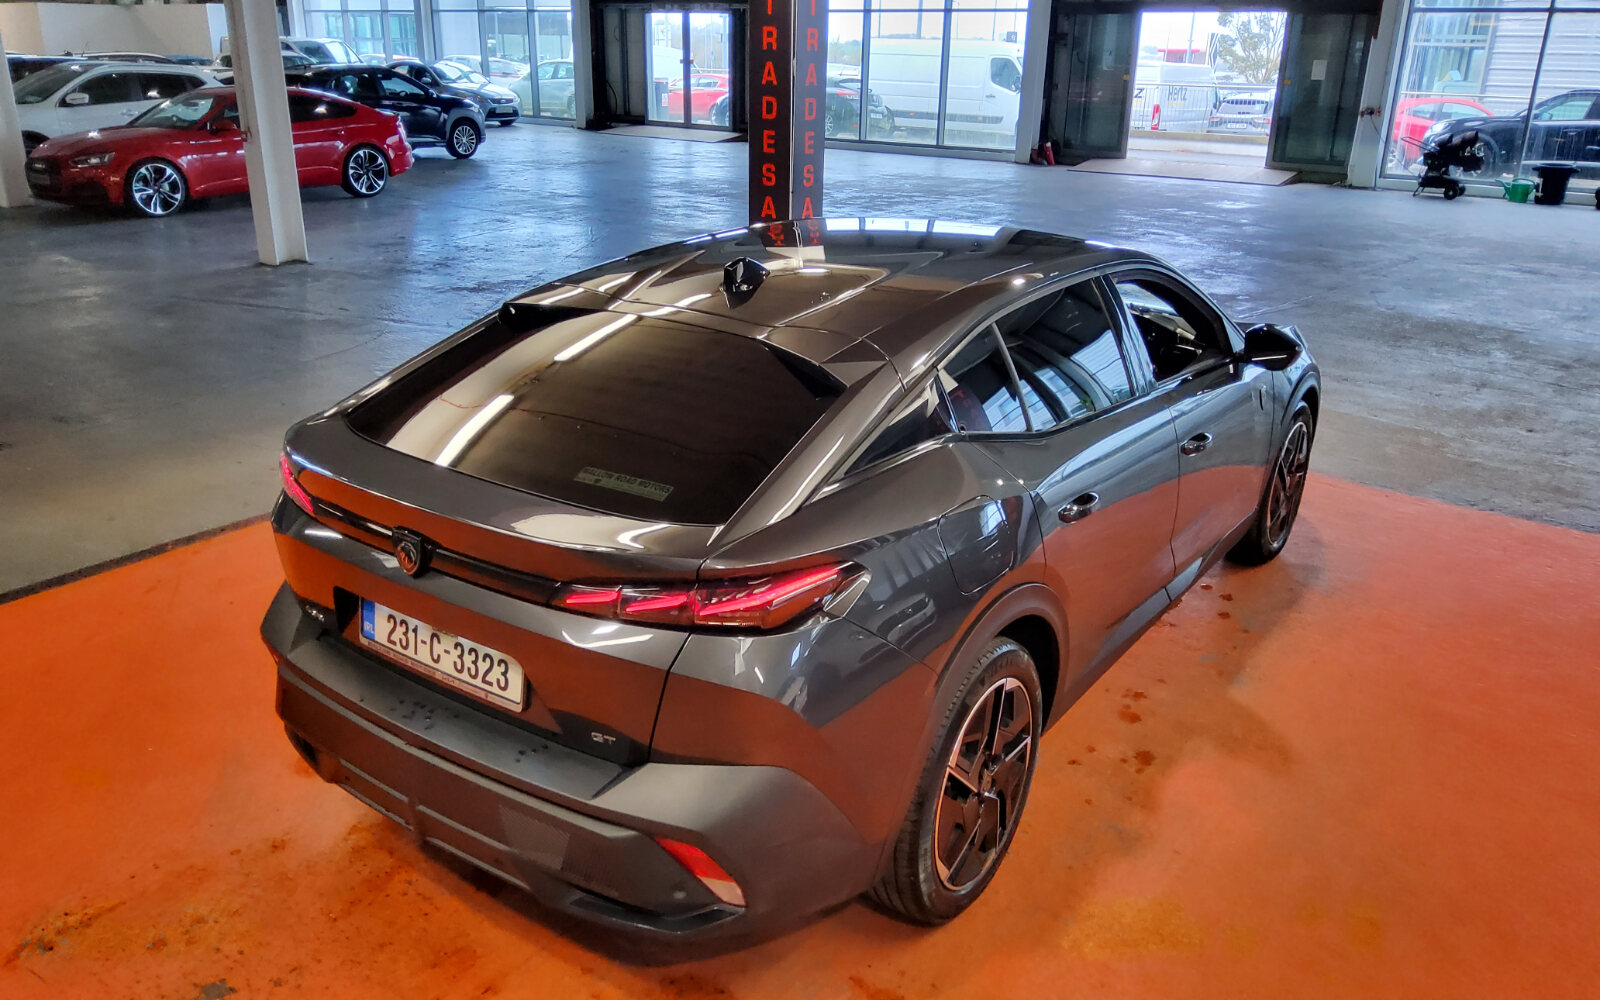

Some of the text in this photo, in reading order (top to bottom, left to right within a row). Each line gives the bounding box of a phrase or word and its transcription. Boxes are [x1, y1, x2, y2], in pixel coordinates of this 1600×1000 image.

[1167, 86, 1188, 102] Hertz
[363, 621, 375, 634] IRL
[386, 614, 510, 692] 231-C-3323
[591, 731, 617, 745] GT
